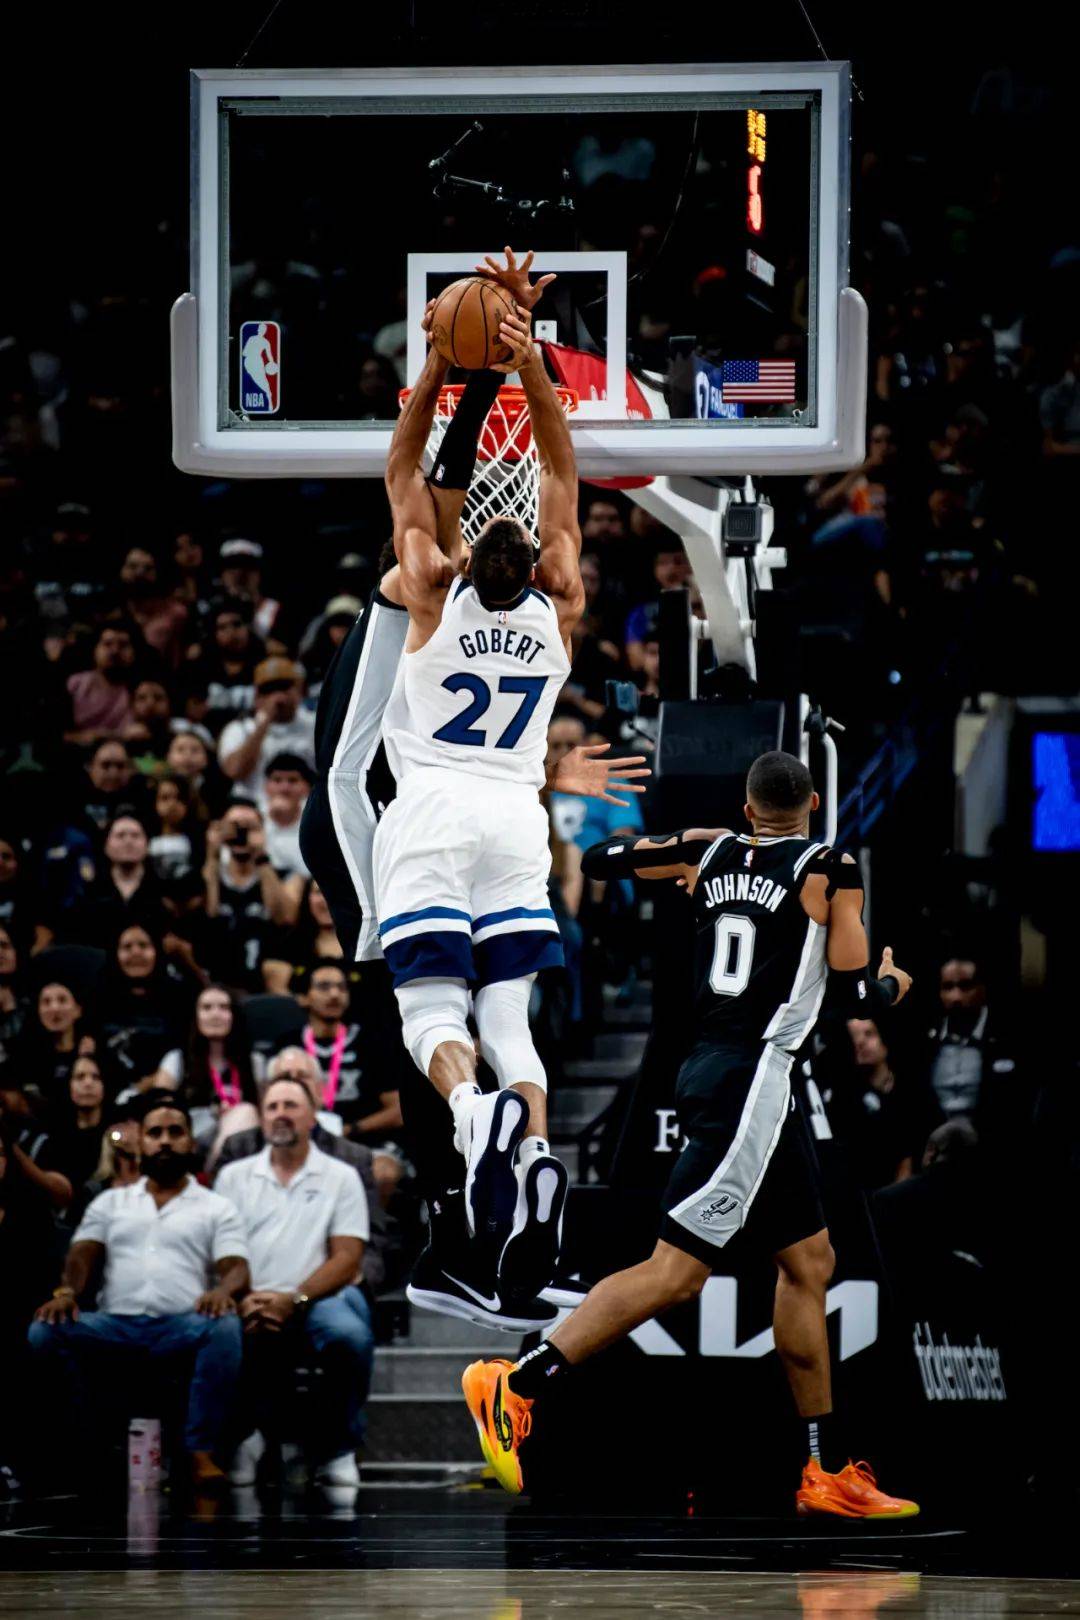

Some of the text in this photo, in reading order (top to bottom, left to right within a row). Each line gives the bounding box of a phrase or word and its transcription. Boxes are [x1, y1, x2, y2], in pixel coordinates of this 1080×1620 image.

[245, 392, 265, 408] NBA
[458, 628, 546, 664] GOBERT
[432, 672, 549, 749] 27
[703, 873, 788, 913] JOHNSON
[708, 912, 757, 997] 0
